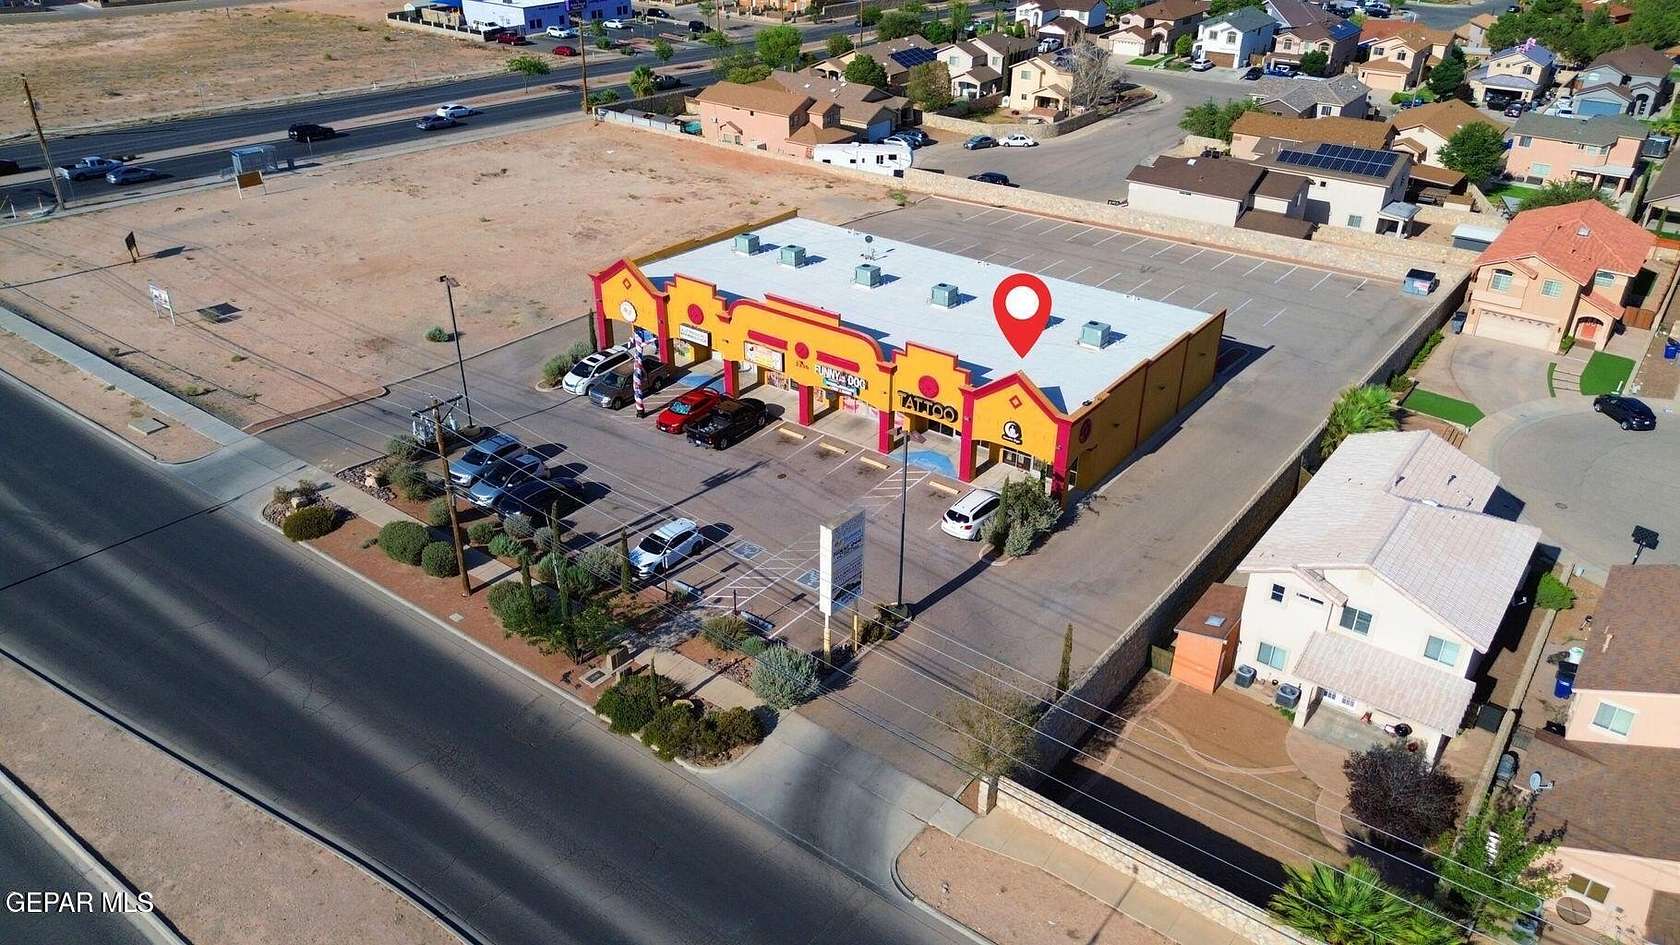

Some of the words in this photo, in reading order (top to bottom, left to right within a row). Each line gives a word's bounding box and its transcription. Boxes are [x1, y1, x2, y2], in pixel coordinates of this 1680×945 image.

[815, 364, 842, 381] FUNNY
[847, 374, 867, 390] DOG
[898, 391, 958, 423] TATTOO
